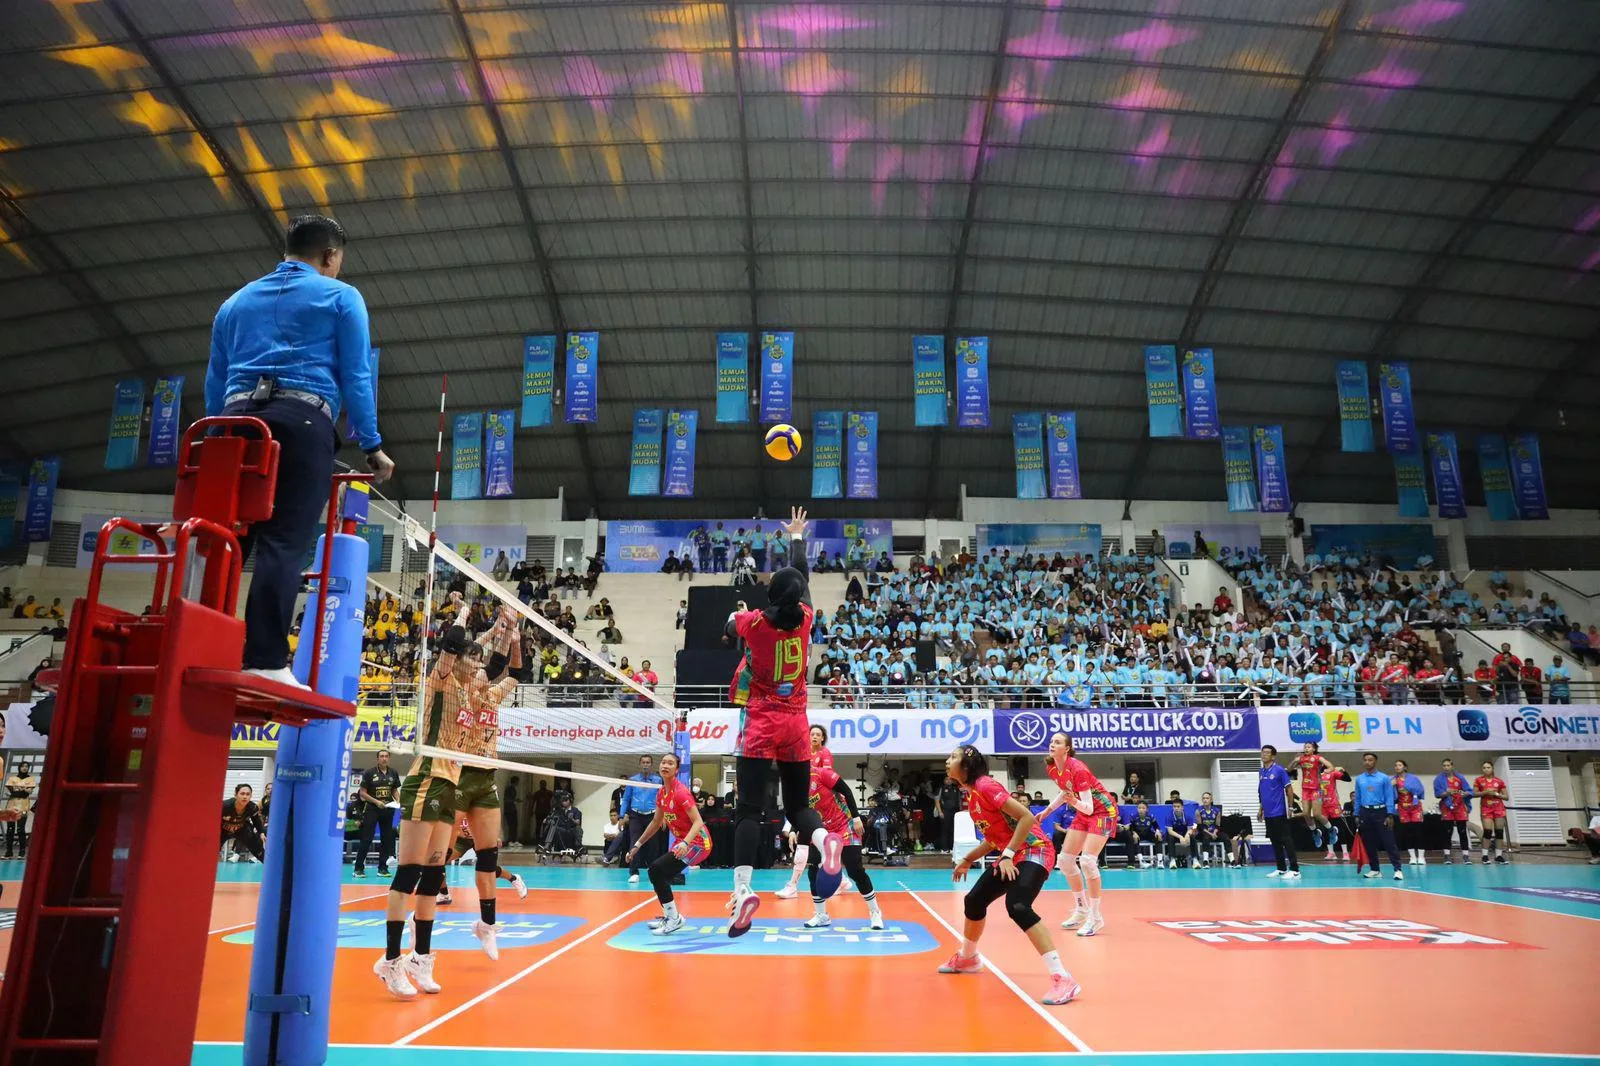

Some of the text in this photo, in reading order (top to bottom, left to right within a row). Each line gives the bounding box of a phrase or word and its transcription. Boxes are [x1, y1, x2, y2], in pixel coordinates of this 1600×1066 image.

[858, 527, 880, 535] PLN
[773, 637, 802, 682] 19
[1050, 711, 1243, 733] SUNRISECLICK.CO.ID
[1366, 717, 1422, 735] PLN
[1460, 724, 1488, 734] ICON
[1505, 716, 1600, 735] ICONNET
[525, 725, 604, 741] Terlengkap
[607, 726, 636, 738] Ada
[639, 725, 652, 738] di
[657, 719, 729, 742] Vdio
[1073, 735, 1225, 749] EVERYONE CAN PLAY SPORTS
[1148, 919, 1440, 931] Bima
[763, 933, 911, 943] PLN
[1187, 931, 1510, 945] Kuku
